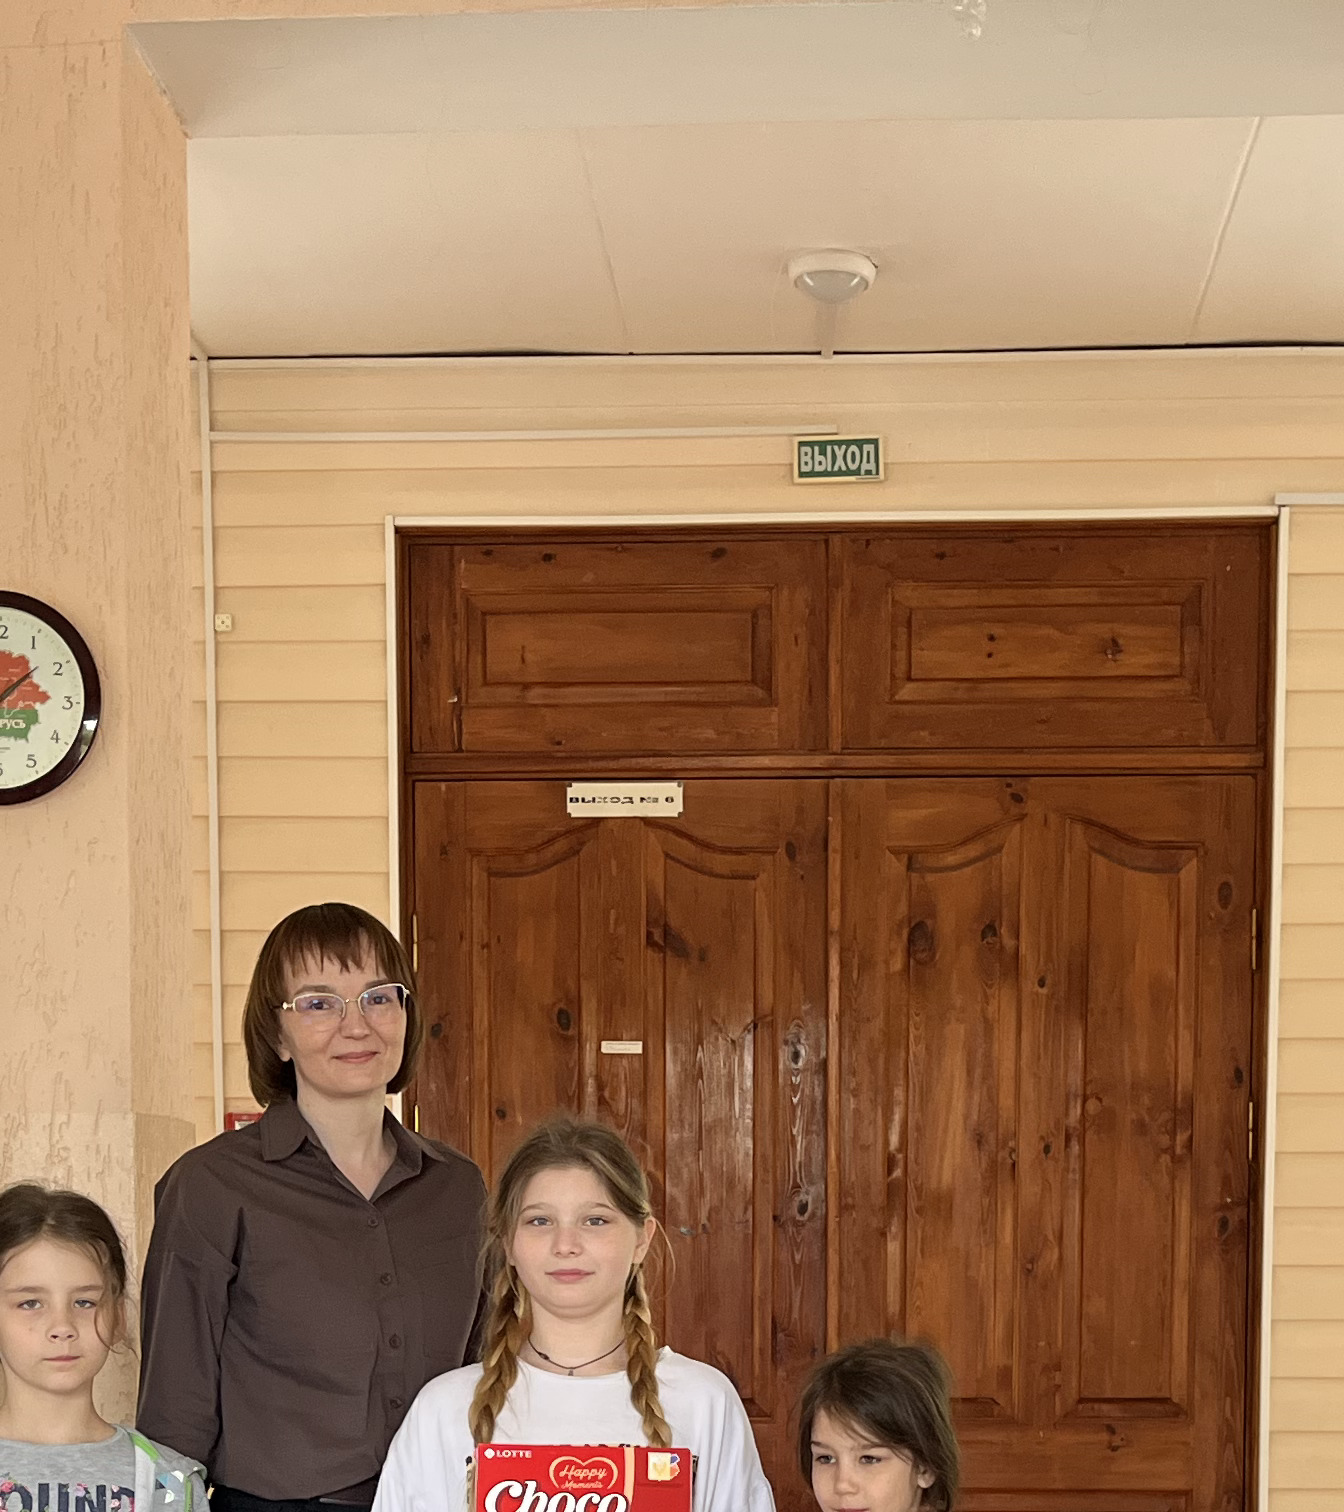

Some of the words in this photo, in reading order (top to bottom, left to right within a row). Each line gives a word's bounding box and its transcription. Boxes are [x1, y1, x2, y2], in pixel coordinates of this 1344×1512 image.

[799, 444, 876, 475] ВЫХОД
[30, 635, 36, 650] 1
[52, 661, 63, 676] 2
[61, 696, 74, 710] 3
[50, 729, 60, 744] 4
[25, 753, 37, 768] 5
[496, 1449, 532, 1459] LOTTE
[559, 1464, 608, 1481] Happy
